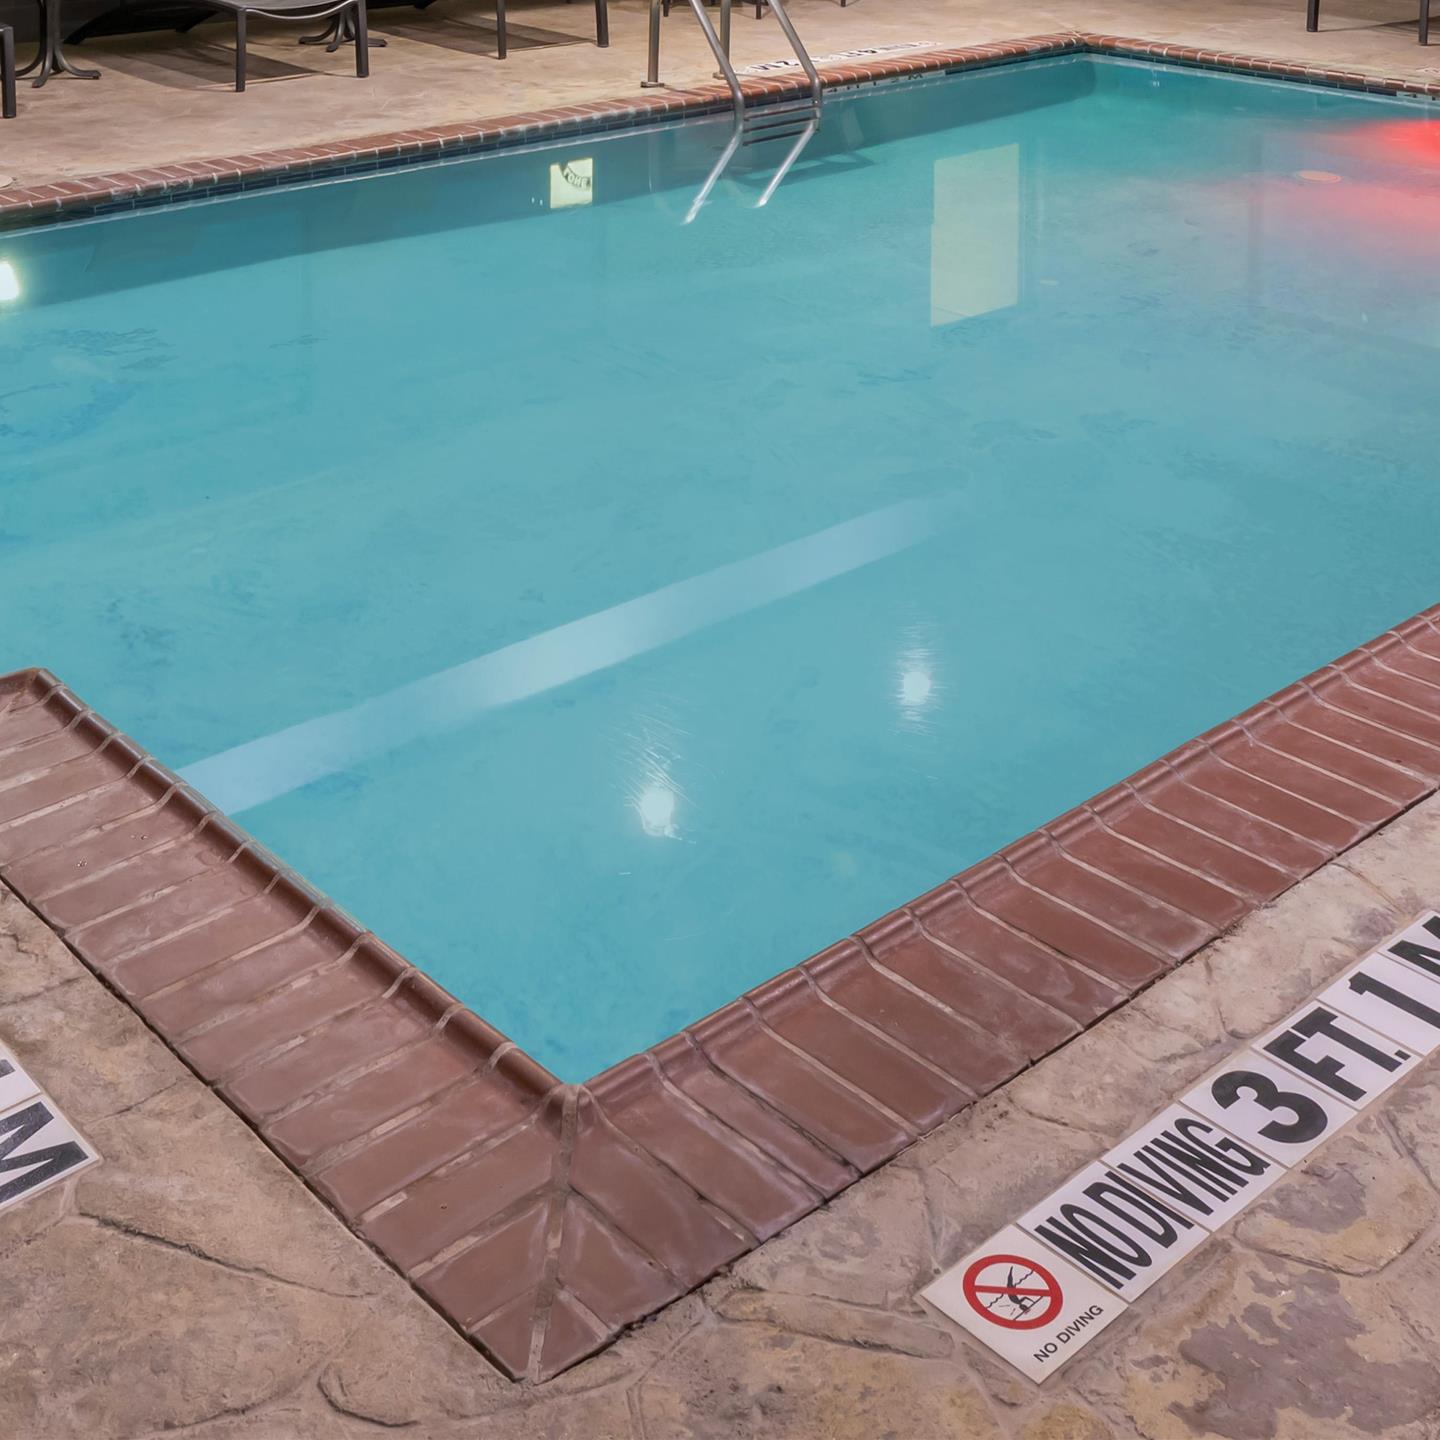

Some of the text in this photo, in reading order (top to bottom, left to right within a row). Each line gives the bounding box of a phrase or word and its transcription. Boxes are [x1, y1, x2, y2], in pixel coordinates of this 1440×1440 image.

[1211, 1068, 1329, 1145] 3
[1082, 1117, 1272, 1250] DIVING
[1034, 1203, 1153, 1291] NO
[1033, 1304, 1105, 1363] NO DIVING
